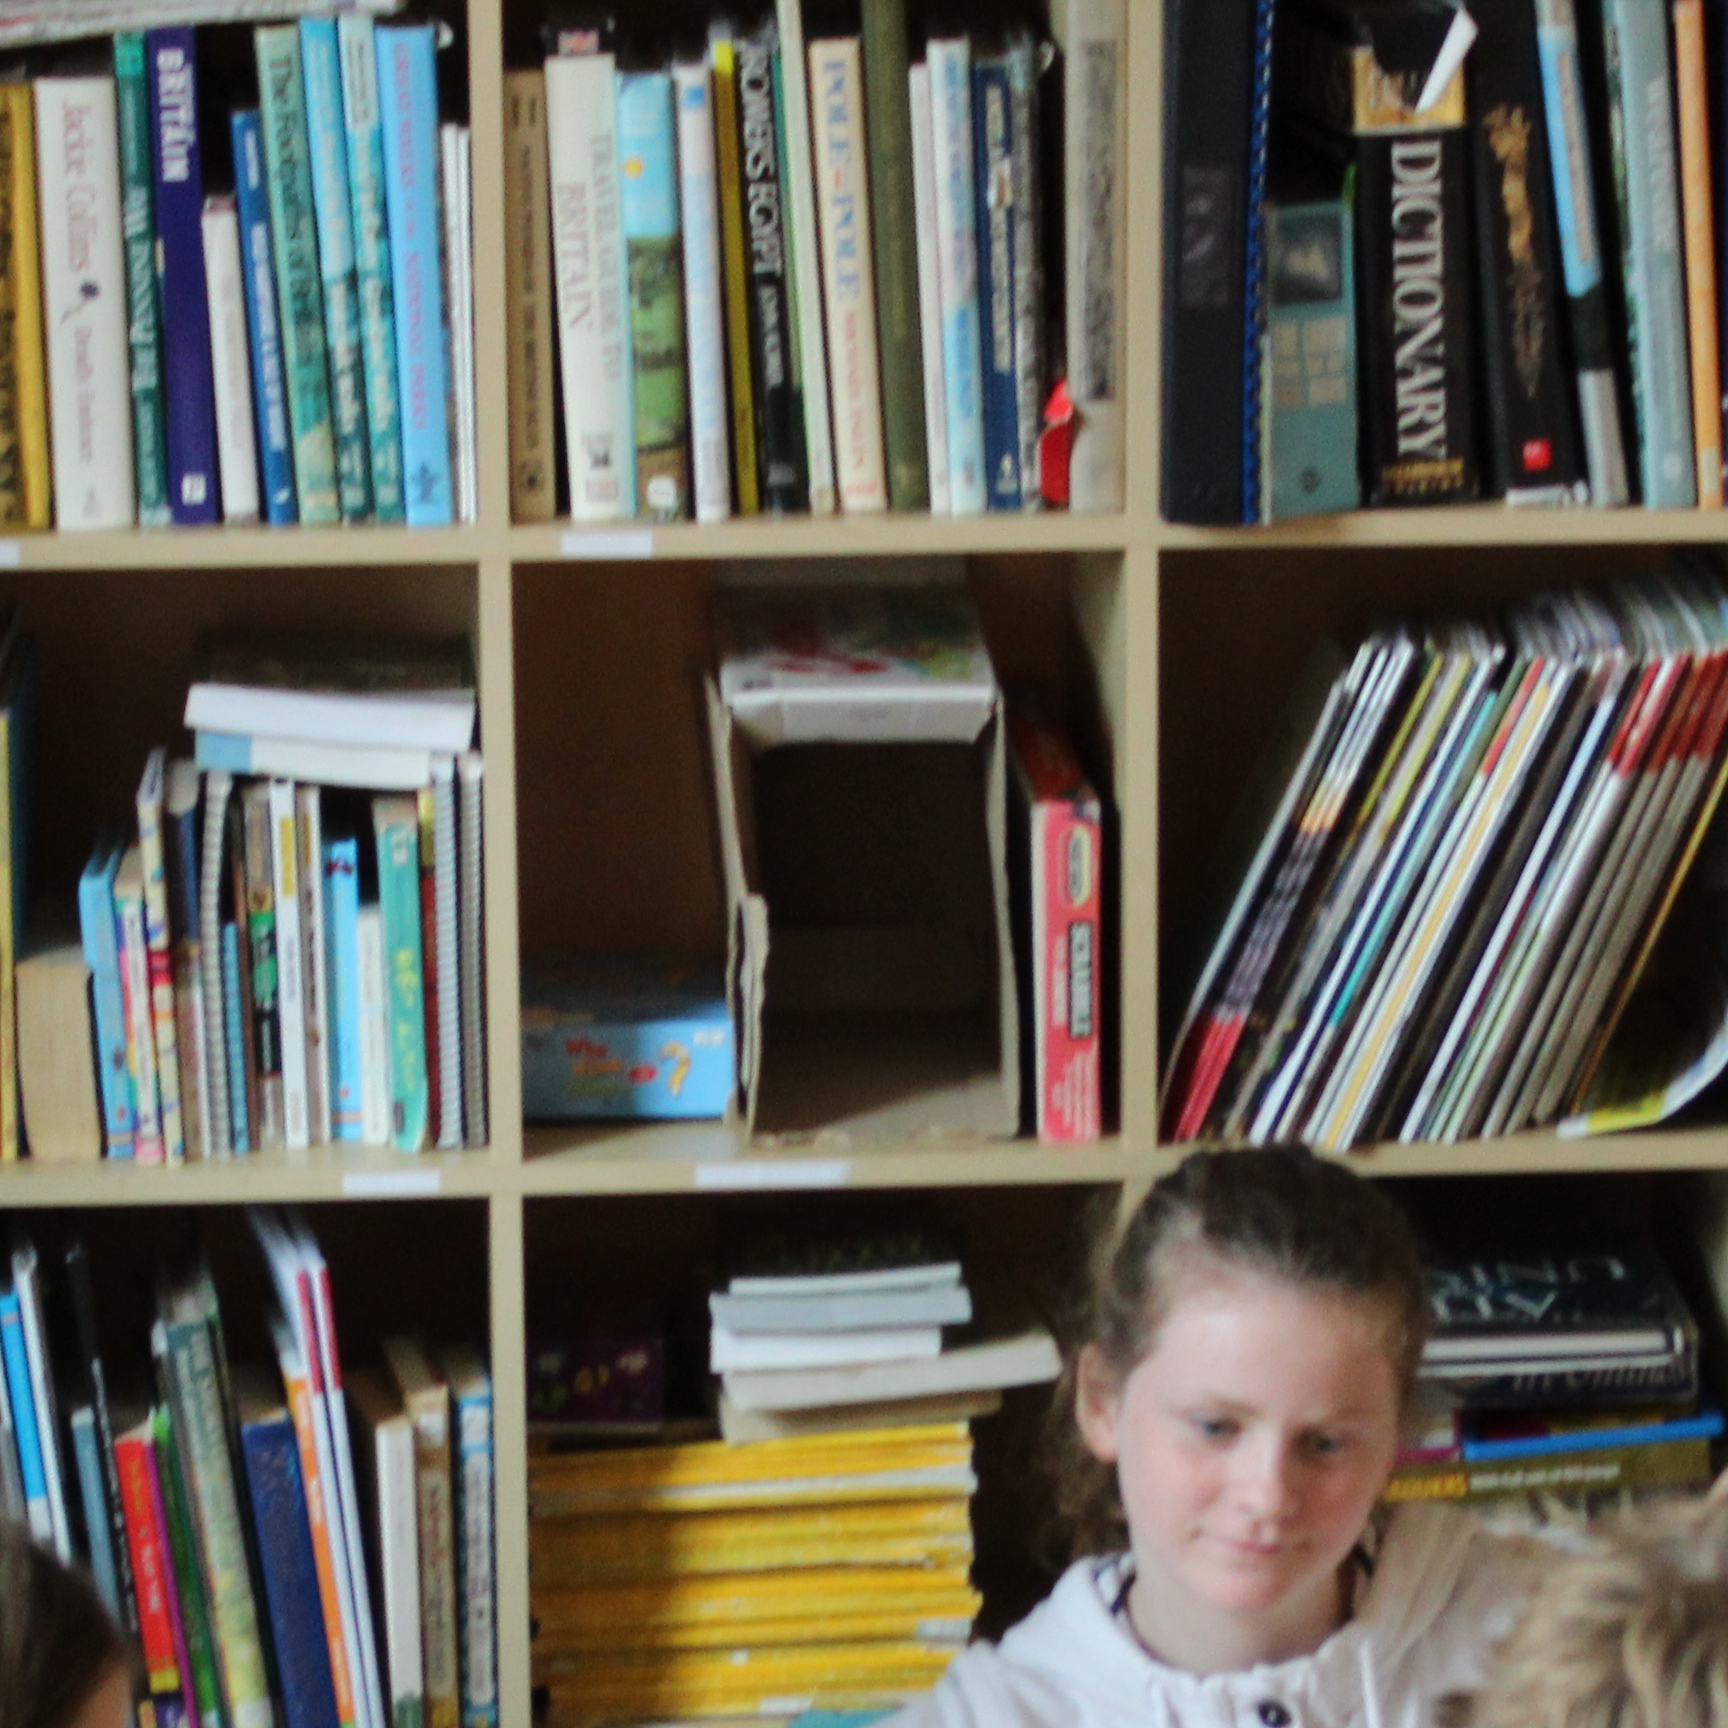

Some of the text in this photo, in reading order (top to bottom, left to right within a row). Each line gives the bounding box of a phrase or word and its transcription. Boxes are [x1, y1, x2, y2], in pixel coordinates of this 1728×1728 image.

[157, 46, 189, 183] BRITAIN
[269, 55, 293, 103] The
[824, 56, 853, 165] POLE
[62, 98, 92, 178] Jackie
[590, 133, 617, 241] TRAVEL
[65, 185, 96, 272] Collins
[558, 182, 592, 329] BRITAIN
[749, 183, 782, 276] EGYPT
[833, 191, 862, 302] POLE
[1388, 139, 1446, 460] DICTIONARY
[601, 343, 622, 382] TO
